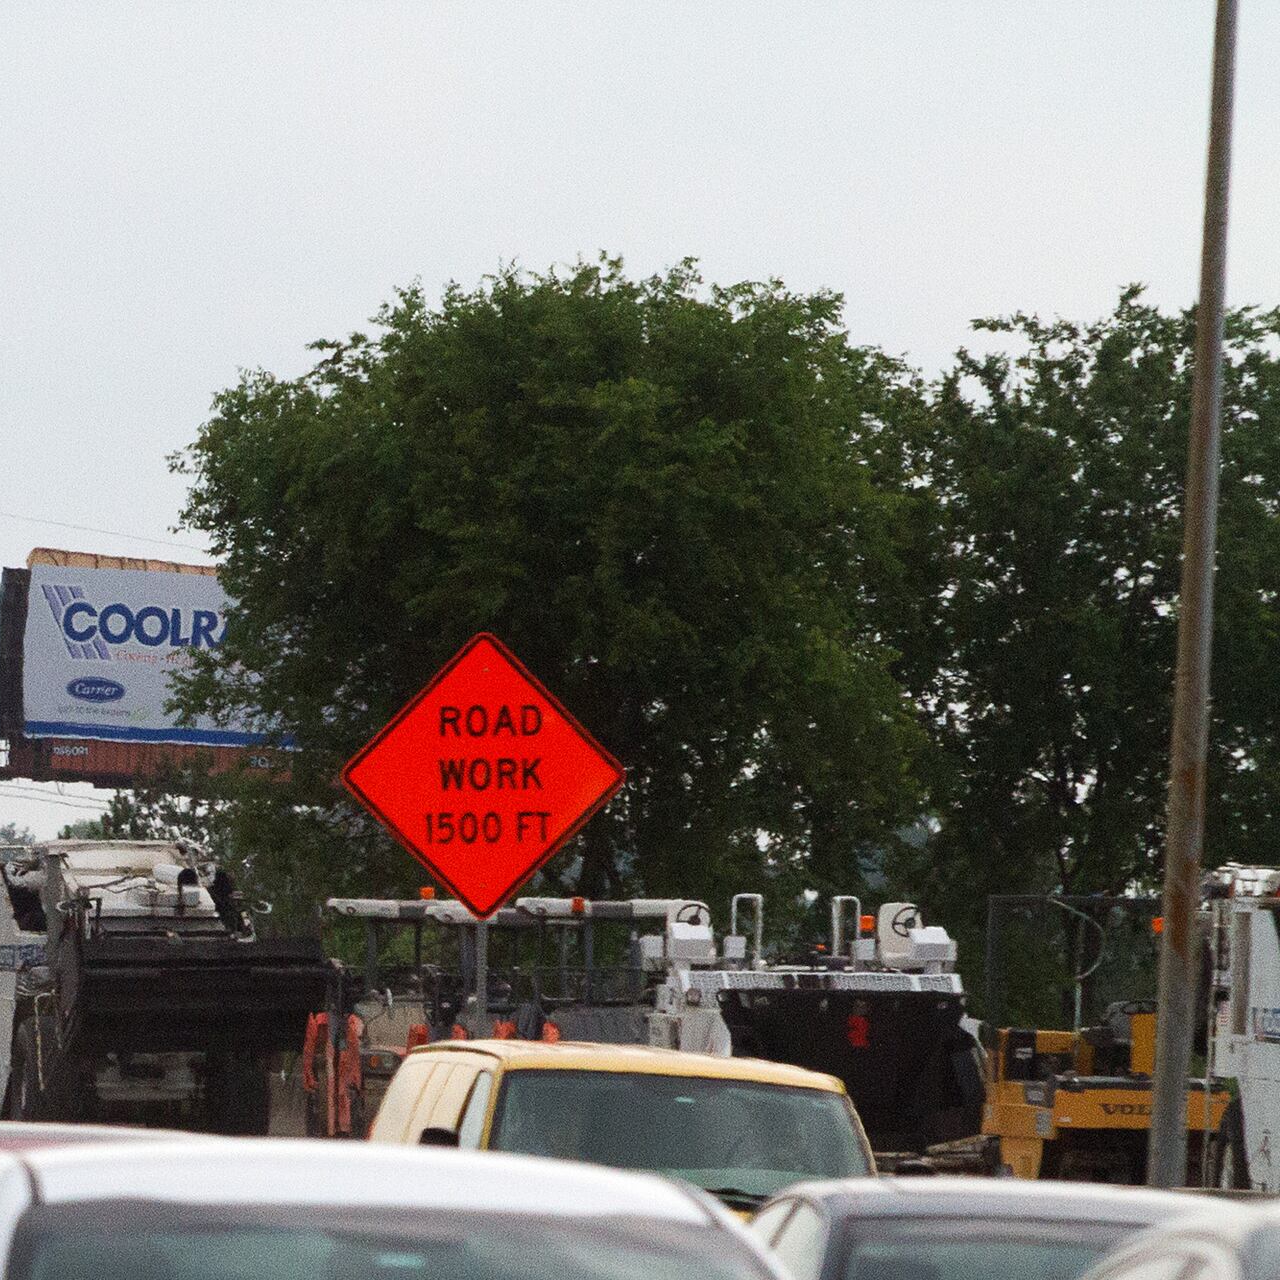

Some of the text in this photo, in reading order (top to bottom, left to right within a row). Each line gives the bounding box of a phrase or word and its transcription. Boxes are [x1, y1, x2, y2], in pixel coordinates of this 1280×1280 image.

[75, 683, 119, 696] Carrier
[440, 704, 542, 737] ROAD
[439, 757, 544, 791] WORK
[425, 811, 552, 845] 1500 FT
